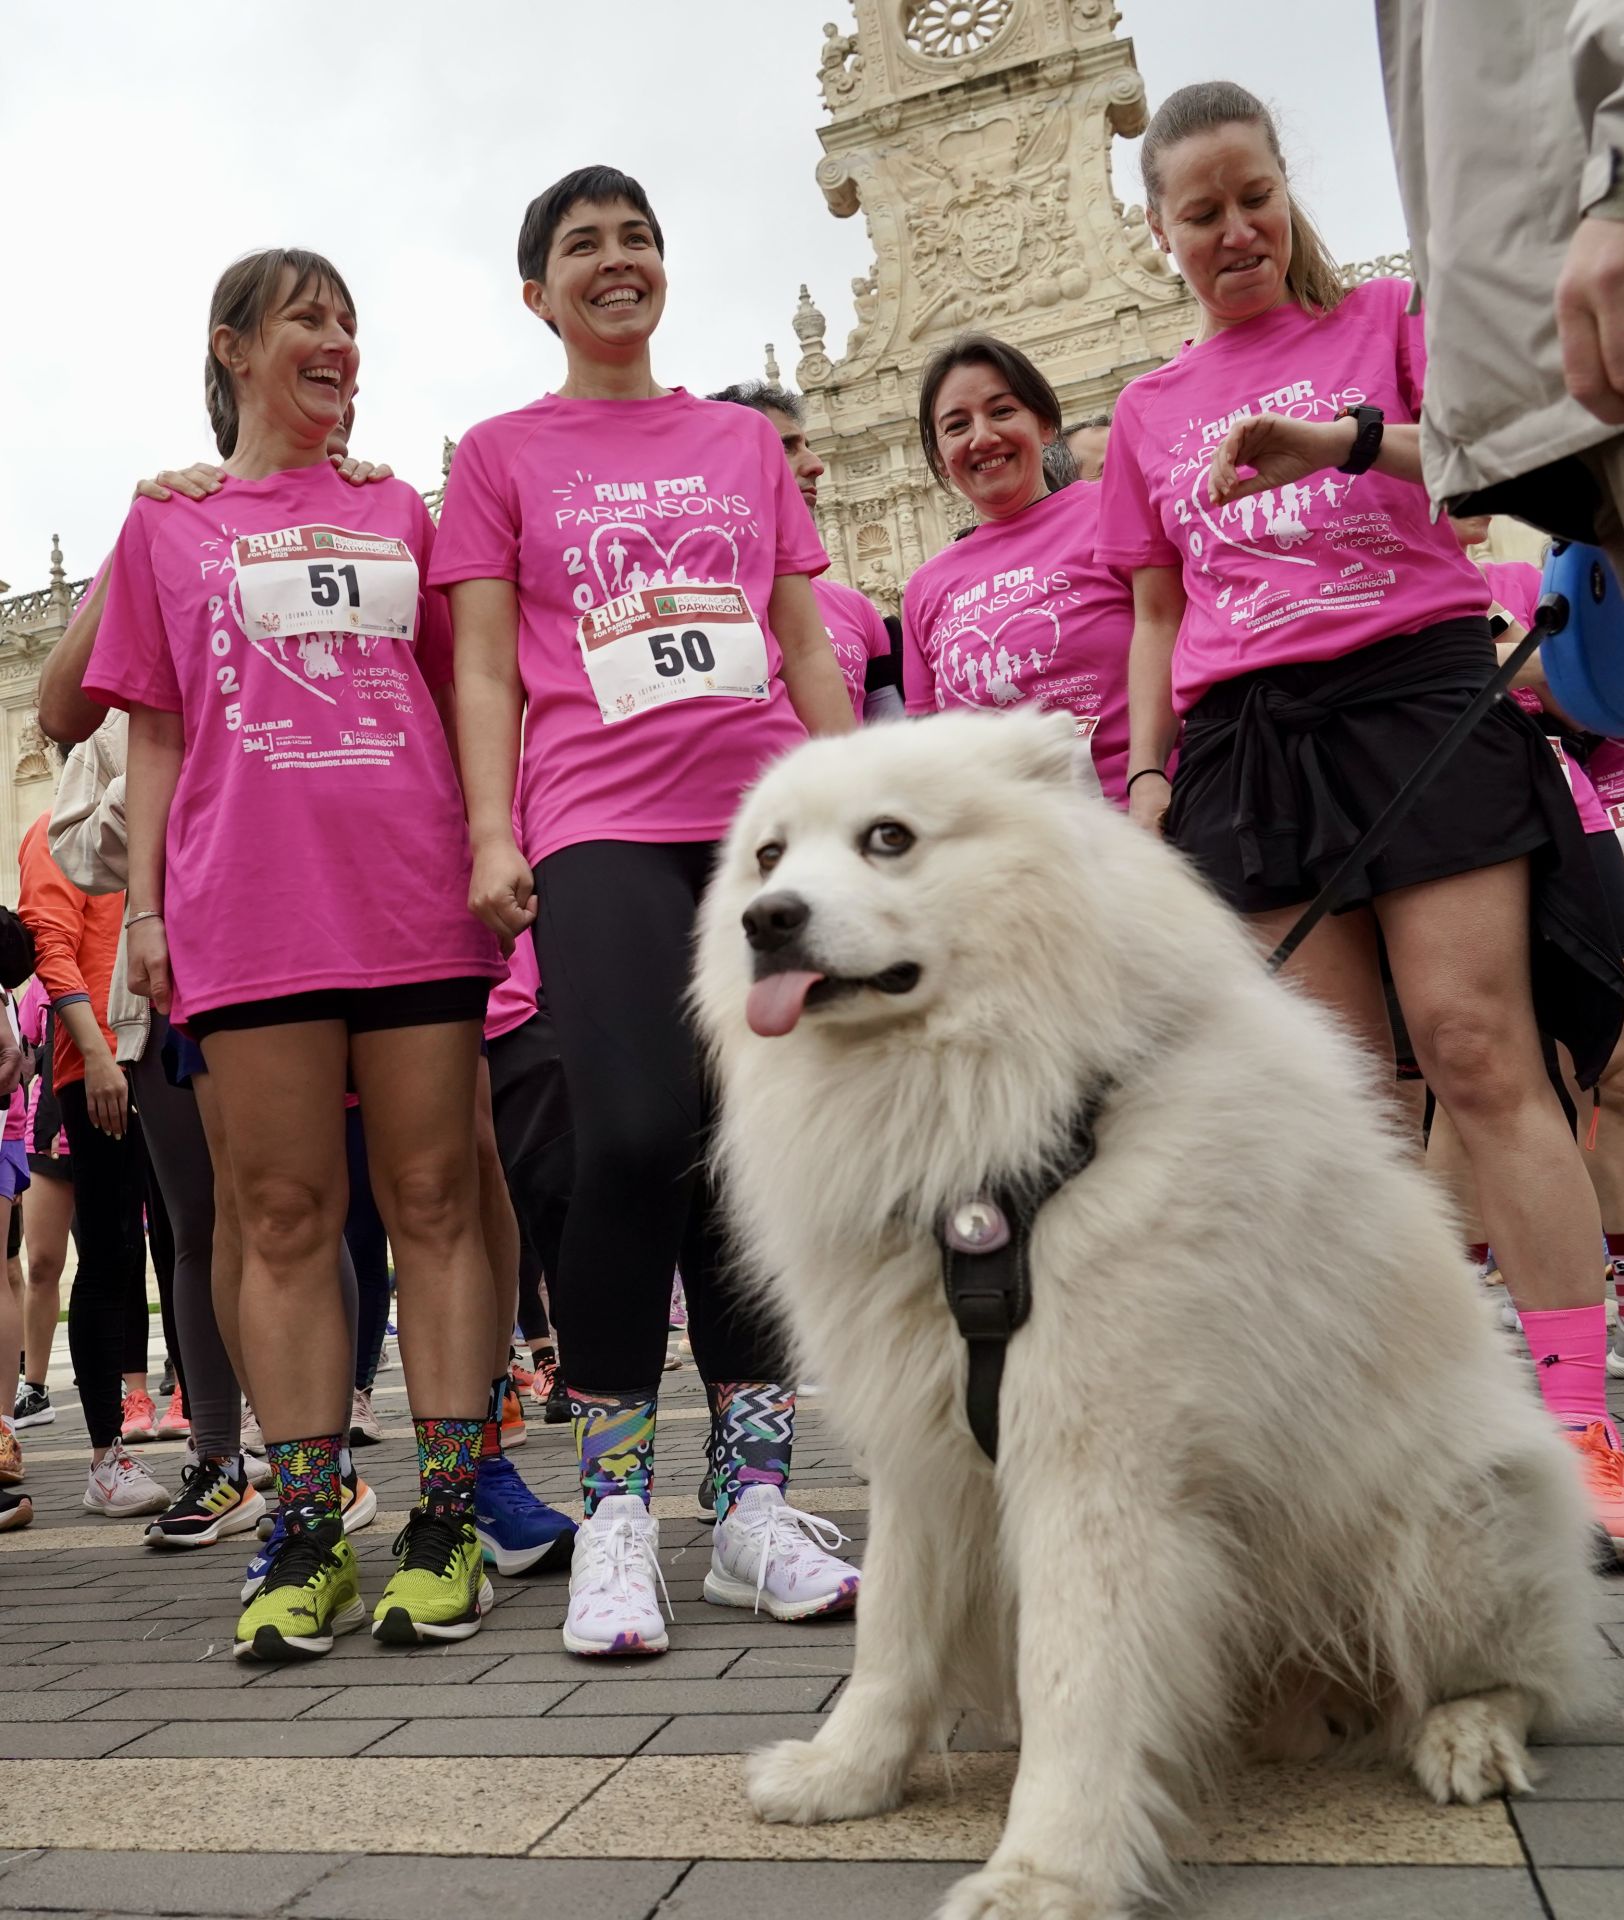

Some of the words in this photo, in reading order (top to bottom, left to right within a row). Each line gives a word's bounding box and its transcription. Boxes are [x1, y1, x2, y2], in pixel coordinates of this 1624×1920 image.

[1202, 404, 1251, 444] RUN
[1259, 380, 1315, 414] FOR
[594, 482, 648, 502] RUN
[654, 475, 707, 497] FOR
[555, 494, 751, 529] PARKINSON'S
[1323, 520, 1340, 529] UN
[1343, 512, 1391, 526] ESFUERZO
[247, 527, 303, 553] RUN
[1332, 542, 1347, 551] UN
[247, 551, 262, 559] FOR
[1373, 543, 1404, 555] UNIDO
[308, 564, 360, 608] 51
[953, 581, 987, 614] RUN
[993, 566, 1035, 593] FOR
[1336, 577, 1390, 593] PARKINSON
[590, 592, 646, 632] RUN
[678, 603, 742, 613] PARKINSON
[931, 571, 1072, 650] PARKINSON'S
[592, 629, 608, 640] FOR
[648, 630, 716, 677] 50
[352, 667, 367, 676] UN
[1049, 674, 1097, 688] ESFUERZO
[357, 690, 371, 700] UN
[242, 719, 293, 733] VILLABLINO
[355, 738, 399, 747] PARKINSON
